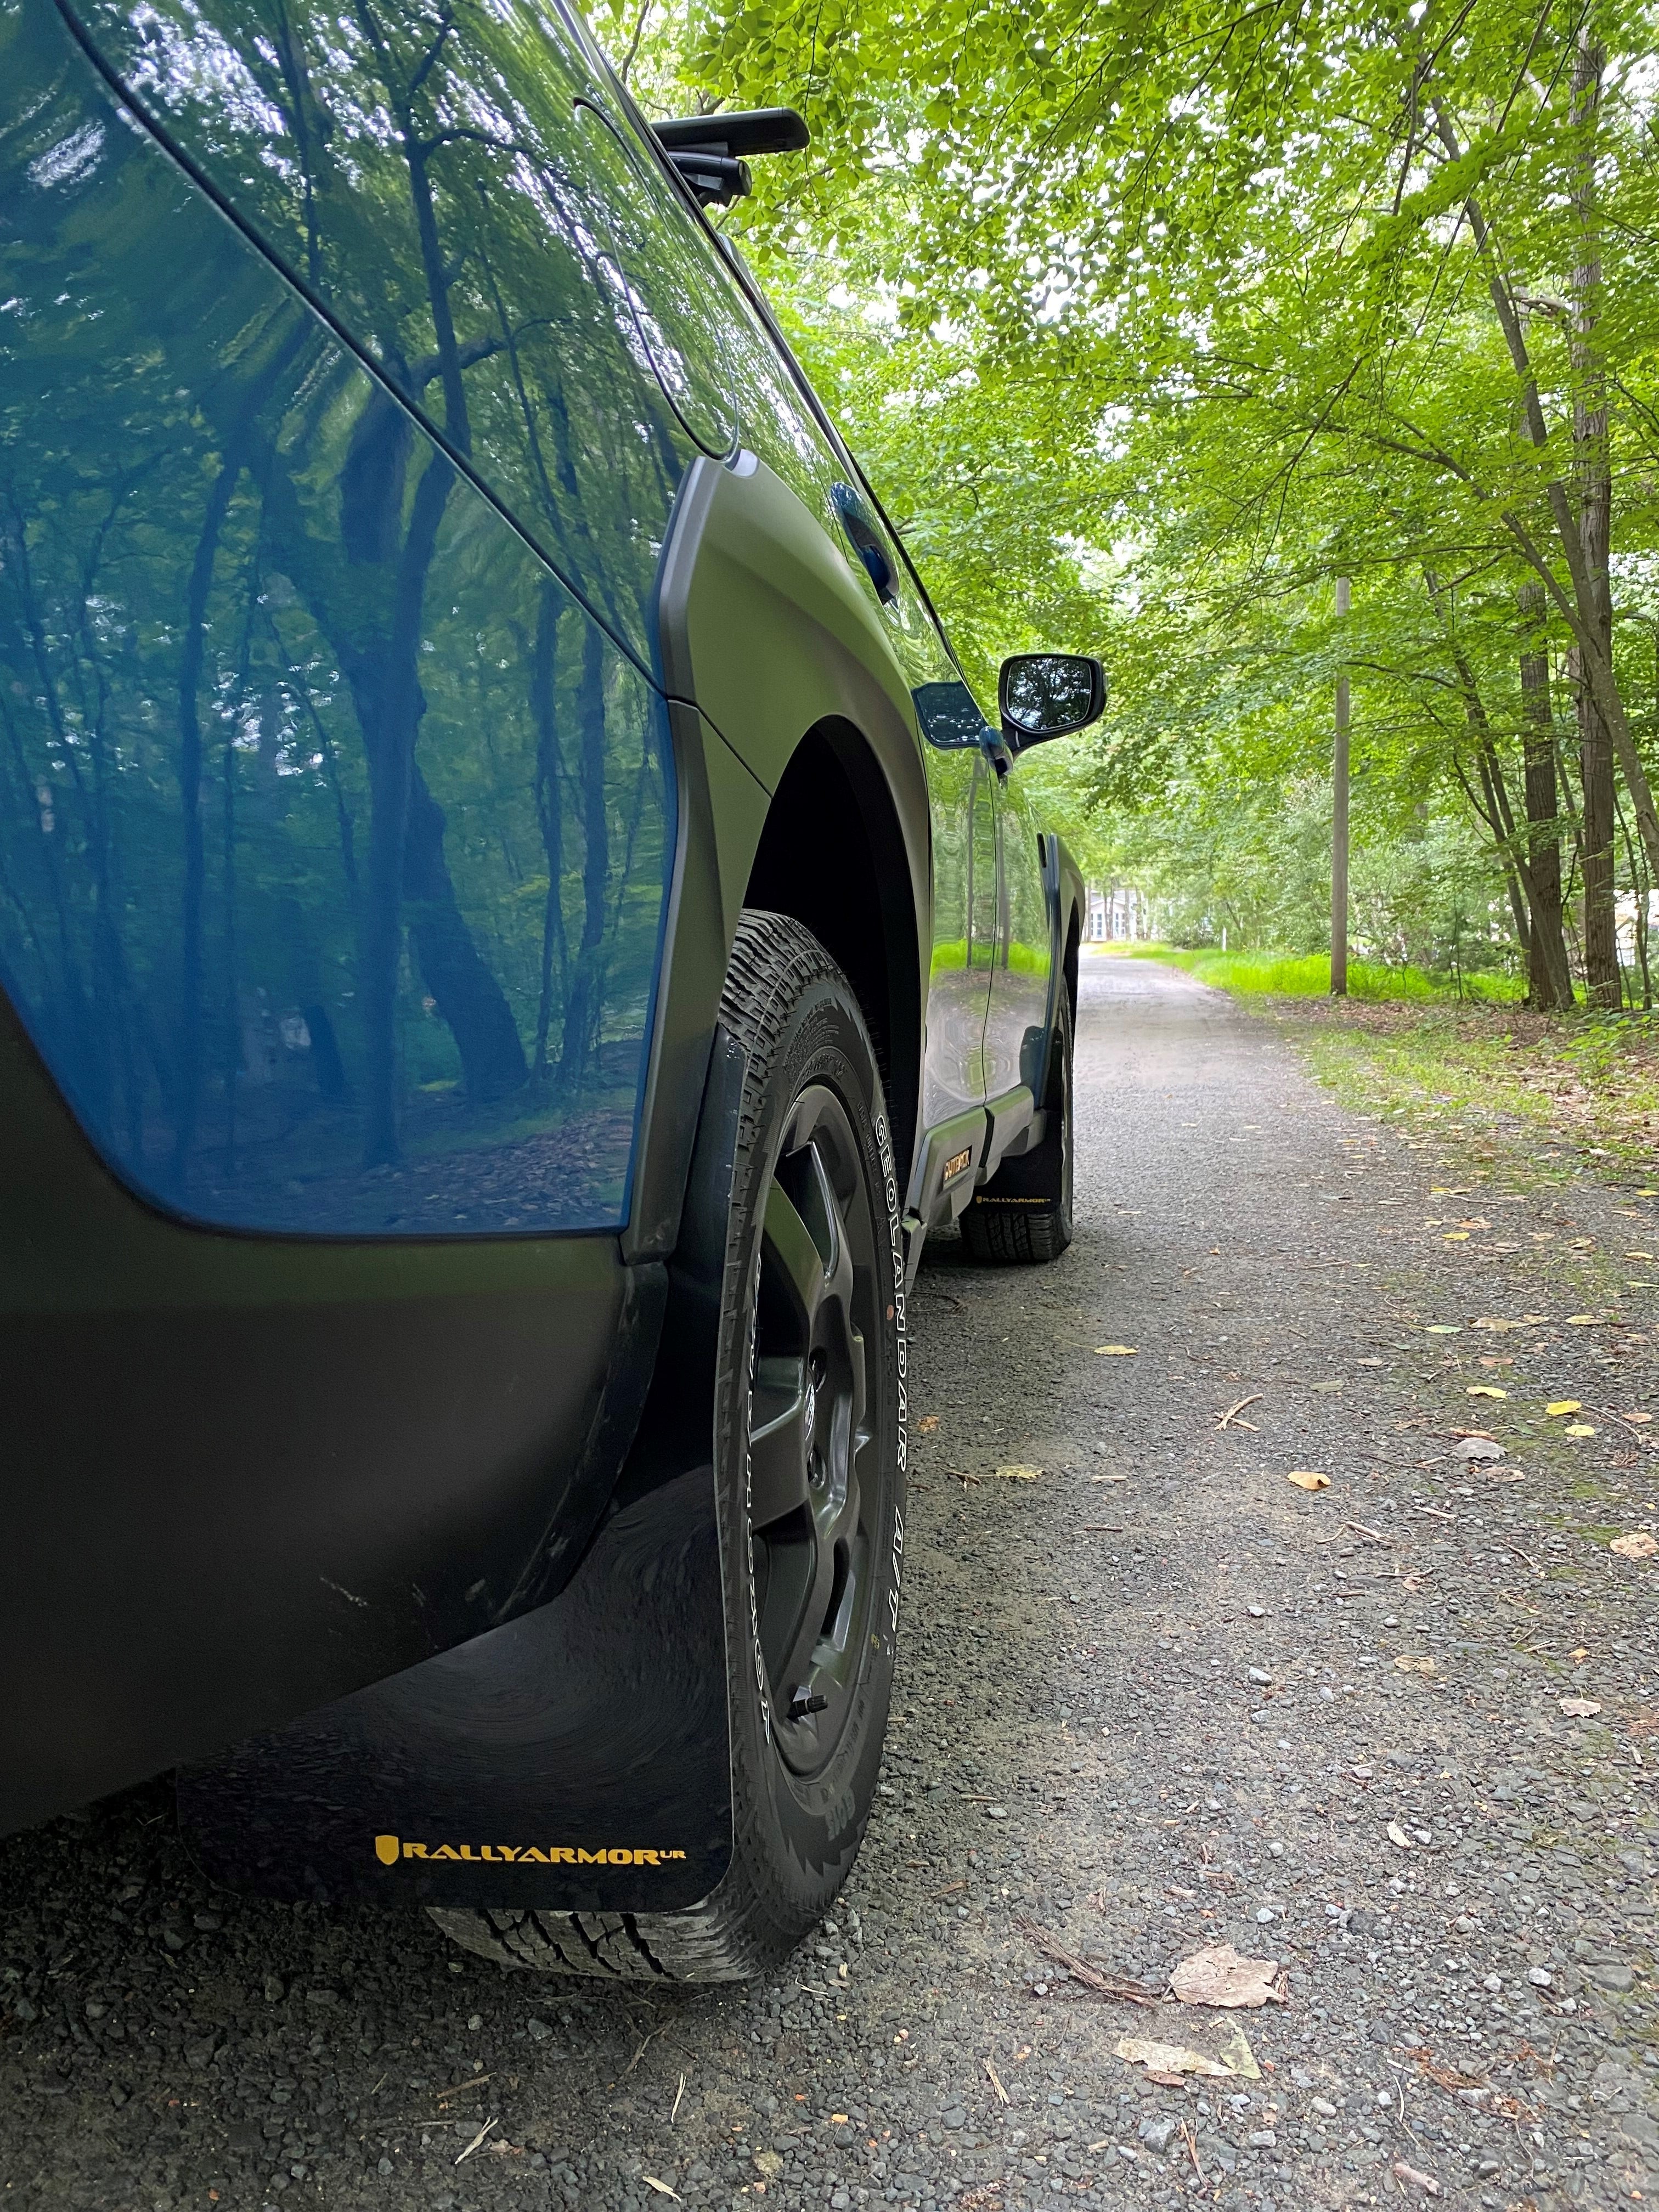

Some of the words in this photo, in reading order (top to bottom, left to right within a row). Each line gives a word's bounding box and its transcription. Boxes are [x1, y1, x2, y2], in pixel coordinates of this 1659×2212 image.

[875, 1113, 907, 1472] GEOLANDAR
[888, 1505, 904, 1632] A/T
[403, 1843, 660, 1865] RALLYARMOR
[660, 1850, 685, 1859] UR
